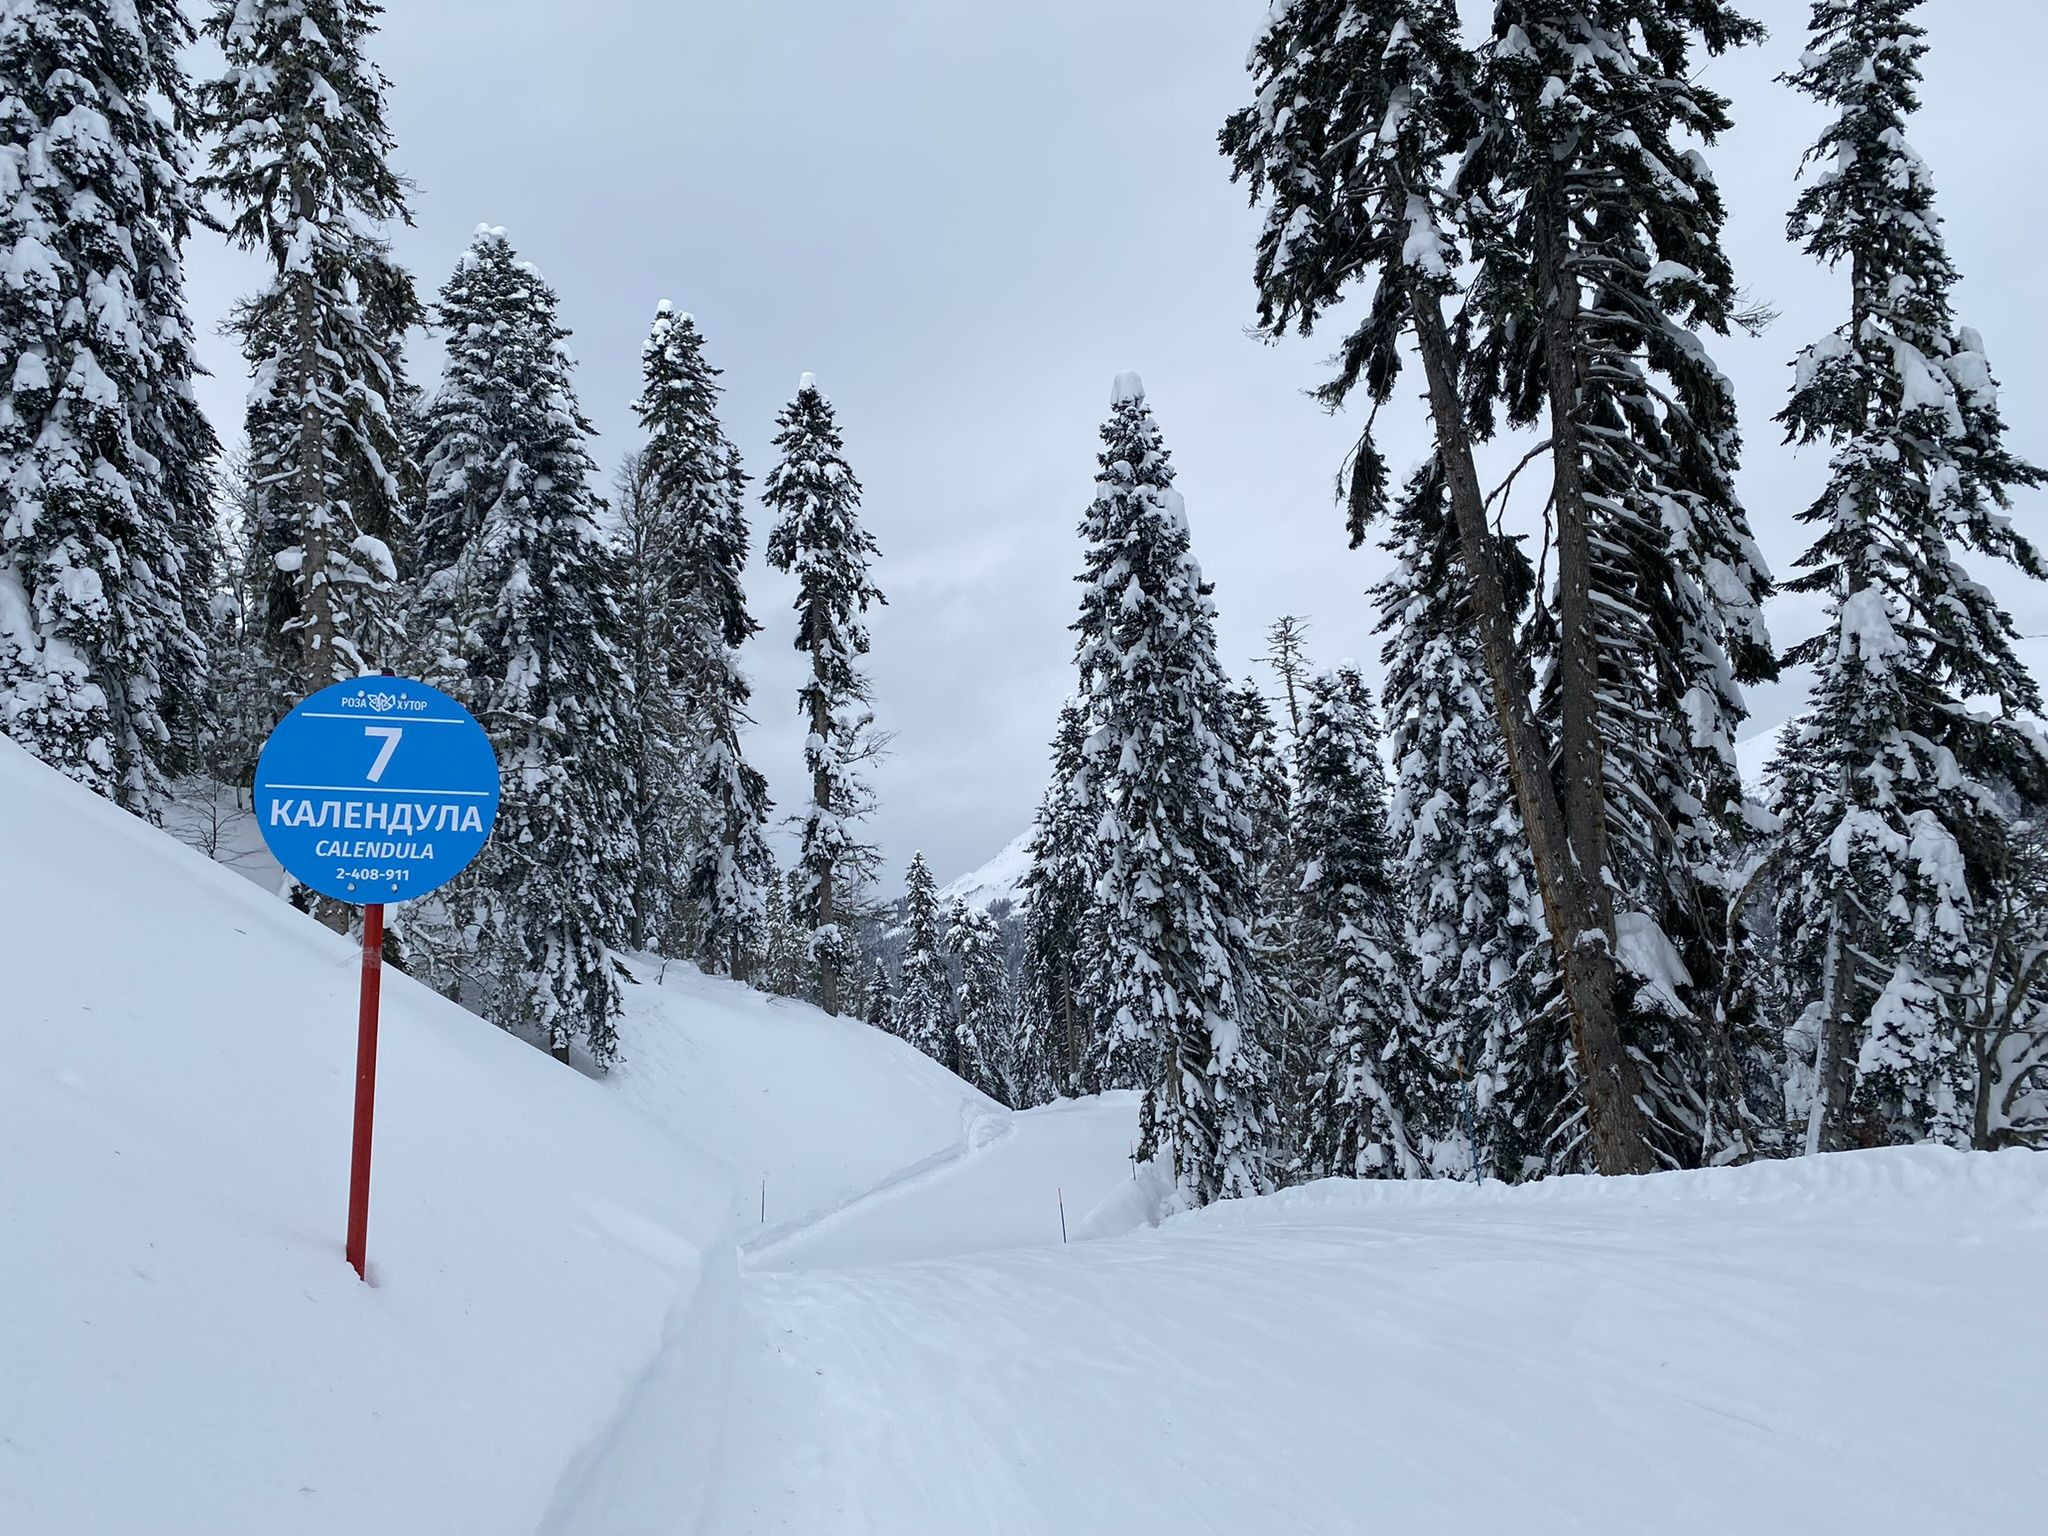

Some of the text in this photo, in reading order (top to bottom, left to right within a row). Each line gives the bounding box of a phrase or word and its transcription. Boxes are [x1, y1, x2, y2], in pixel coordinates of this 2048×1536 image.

[341, 697, 428, 711] РОЗА ХУТОР
[364, 726, 403, 783] 7
[270, 799, 483, 836] КАЛЕНДУЛА
[315, 840, 435, 860] CALENDULA
[336, 868, 410, 881] 2-408-911
